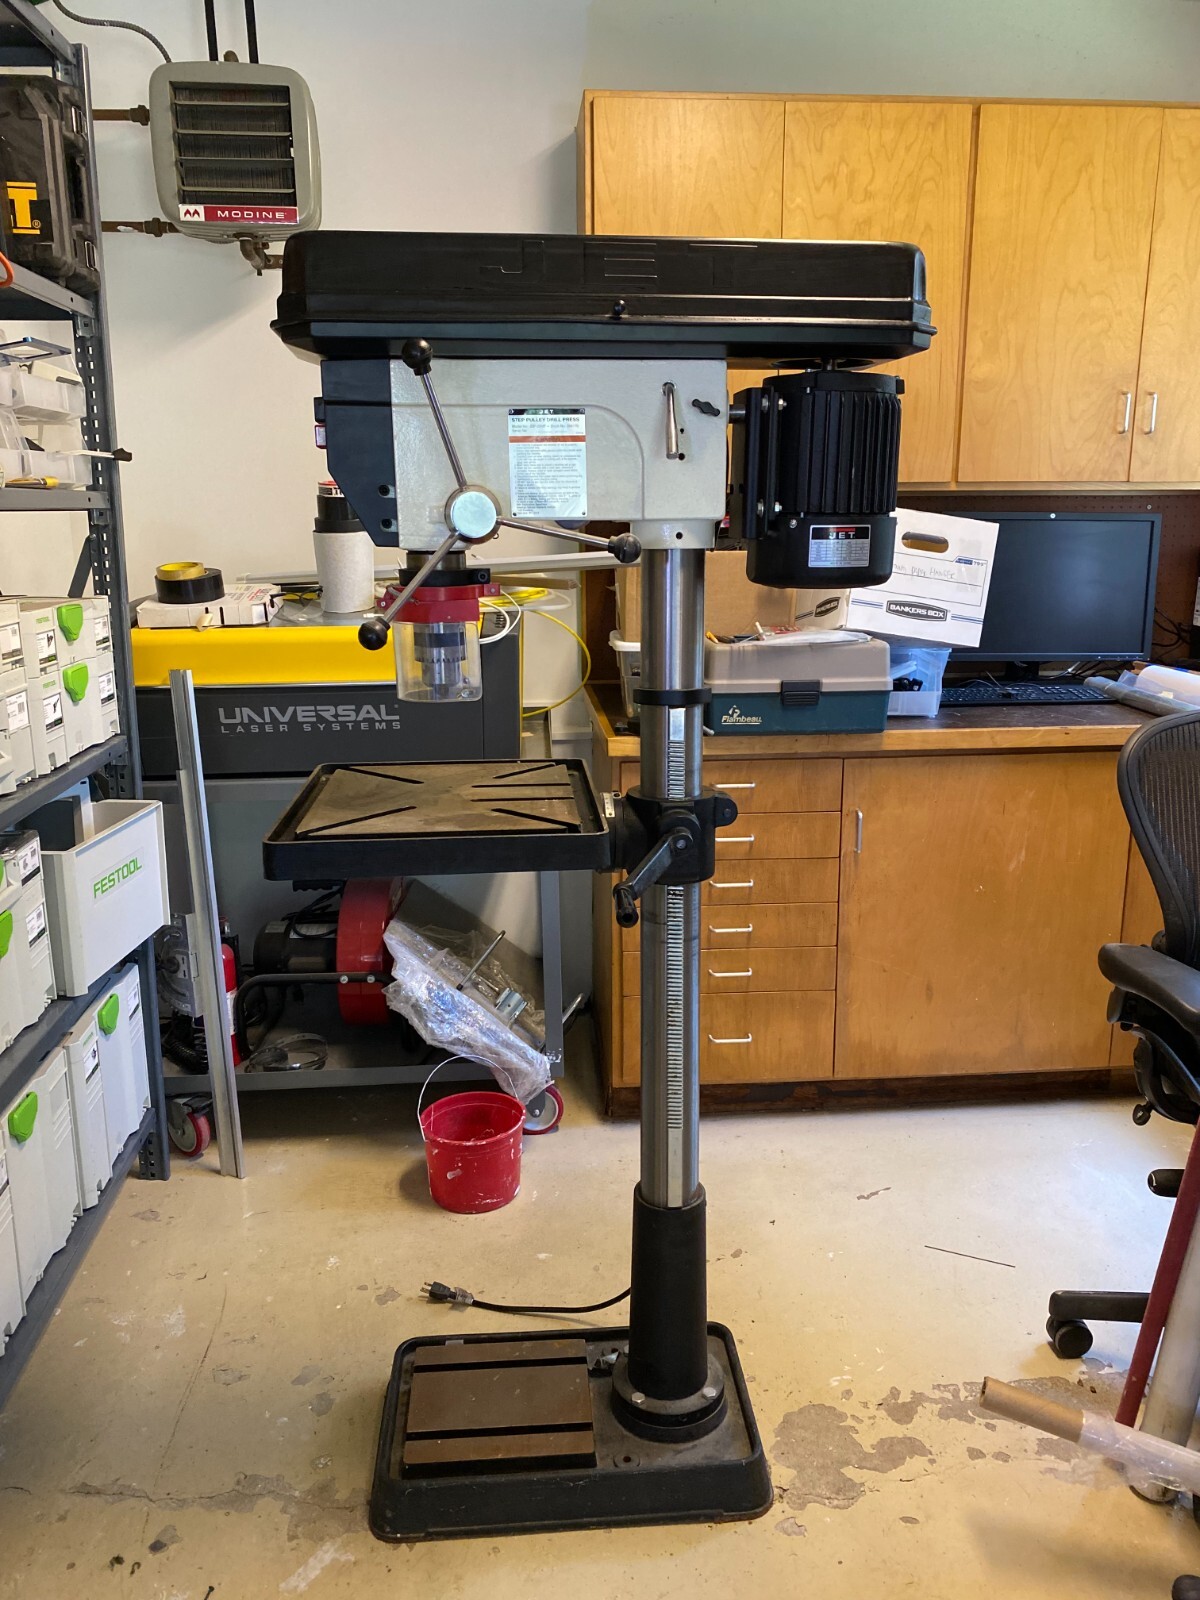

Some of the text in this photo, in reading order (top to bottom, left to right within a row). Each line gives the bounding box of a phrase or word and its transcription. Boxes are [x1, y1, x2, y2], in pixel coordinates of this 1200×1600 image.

[217, 210, 285, 219] MODINE
[889, 603, 945, 618] BANKERS BOX
[218, 704, 400, 723] UNIVERSAL
[721, 715, 762, 723] Flambeau
[221, 721, 401, 734] LASER SYSTEMS
[93, 857, 142, 899] FESTOOL
